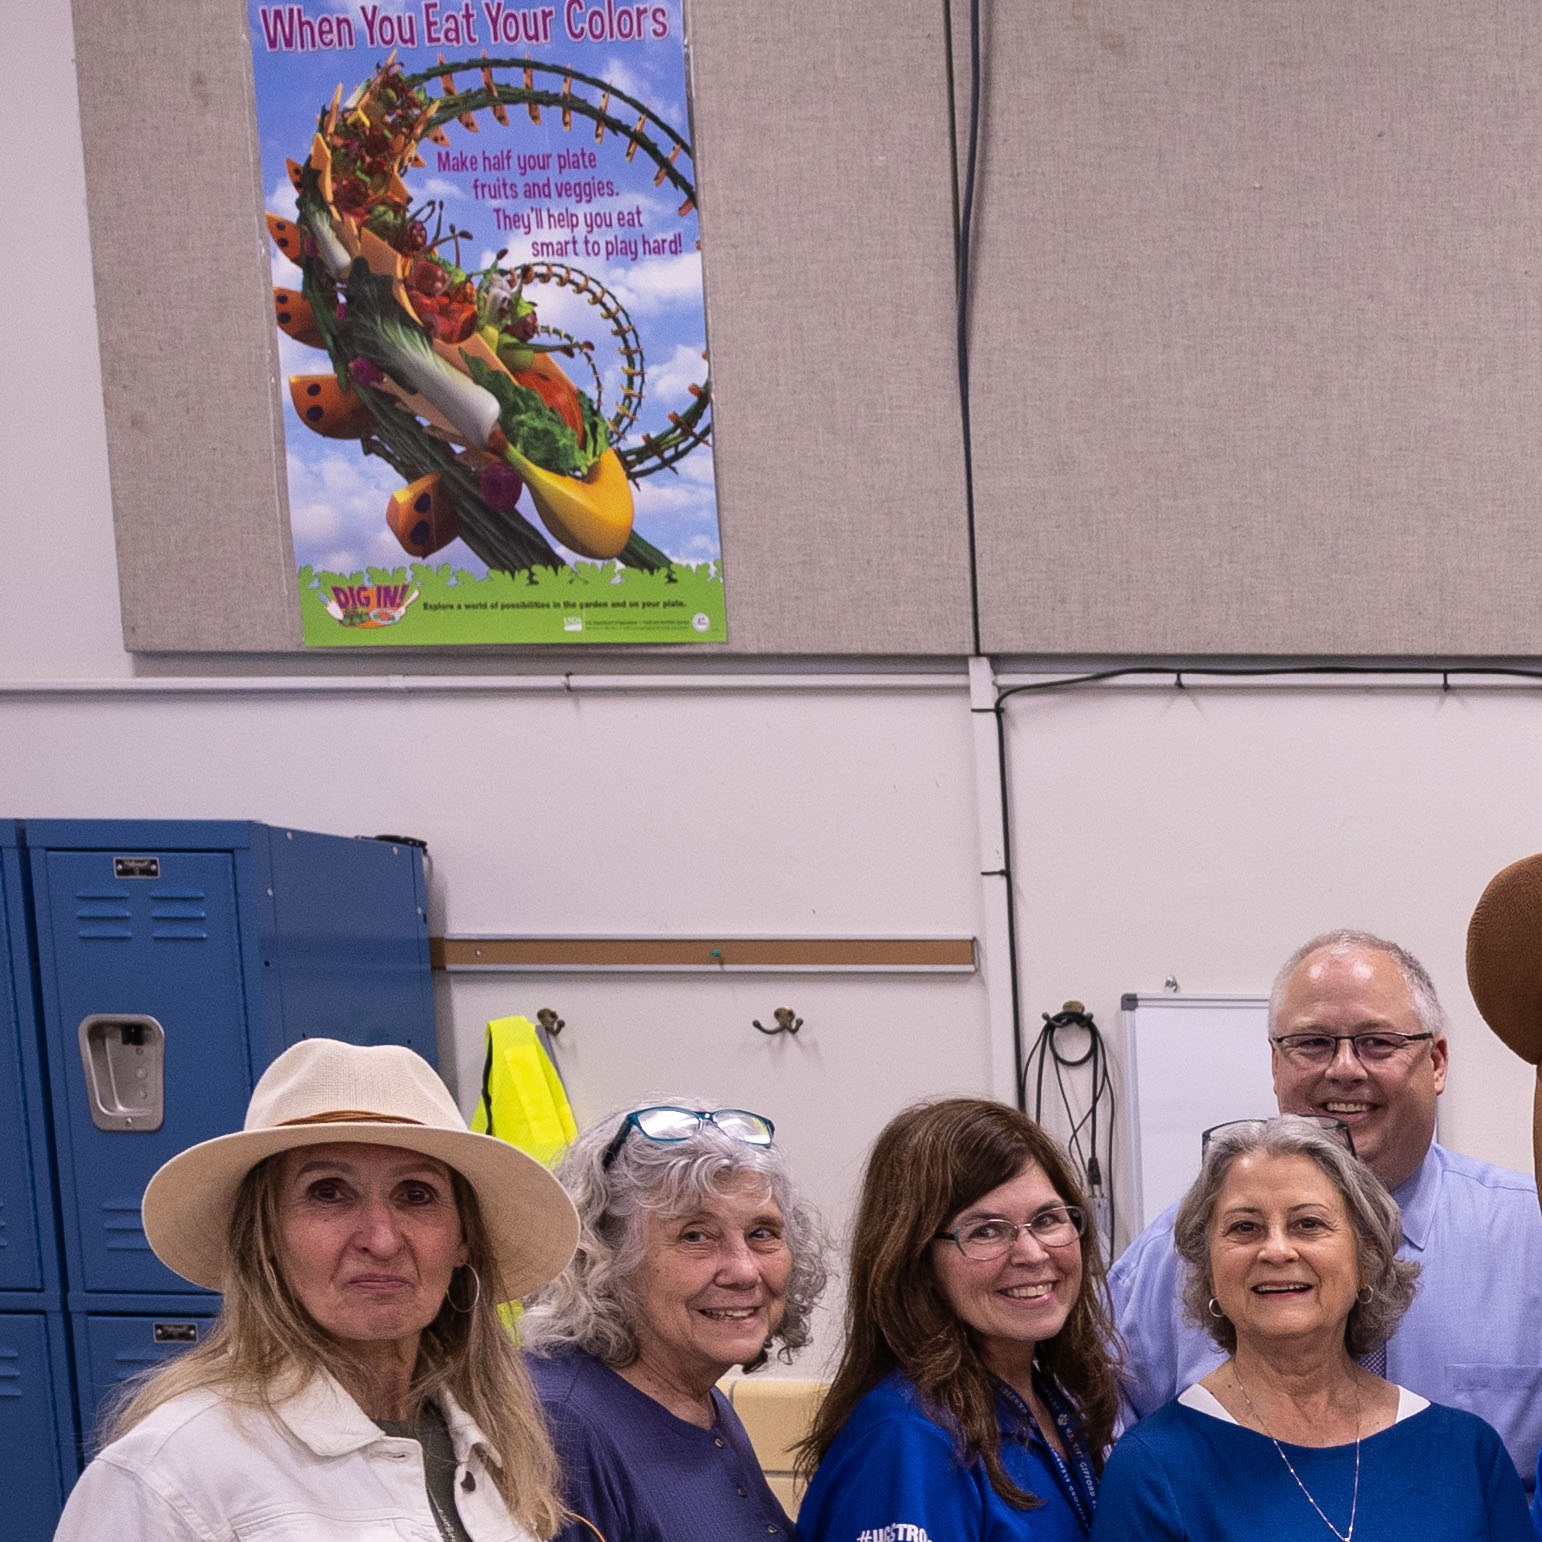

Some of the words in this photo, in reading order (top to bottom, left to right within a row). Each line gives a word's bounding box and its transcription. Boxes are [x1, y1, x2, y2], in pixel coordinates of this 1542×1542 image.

[260, 6, 355, 50] When
[360, 4, 417, 48] You
[423, 1, 478, 46] Eat
[482, 1, 555, 43] Your
[565, 0, 669, 41] Colors
[437, 151, 478, 172] Make
[483, 149, 511, 171] half
[518, 151, 552, 176] your
[557, 148, 597, 174] plate
[473, 178, 518, 200] fruits
[524, 177, 550, 199] and
[555, 176, 620, 203] veggies.
[493, 207, 543, 235] They'll
[547, 208, 579, 234] help
[584, 212, 613, 234] you
[617, 206, 643, 229] eat
[531, 236, 579, 257] smart
[584, 236, 600, 256] to
[605, 235, 639, 261] play
[642, 233, 683, 255] hard!
[331, 585, 371, 609] DIG
[375, 583, 410, 608] IN!
